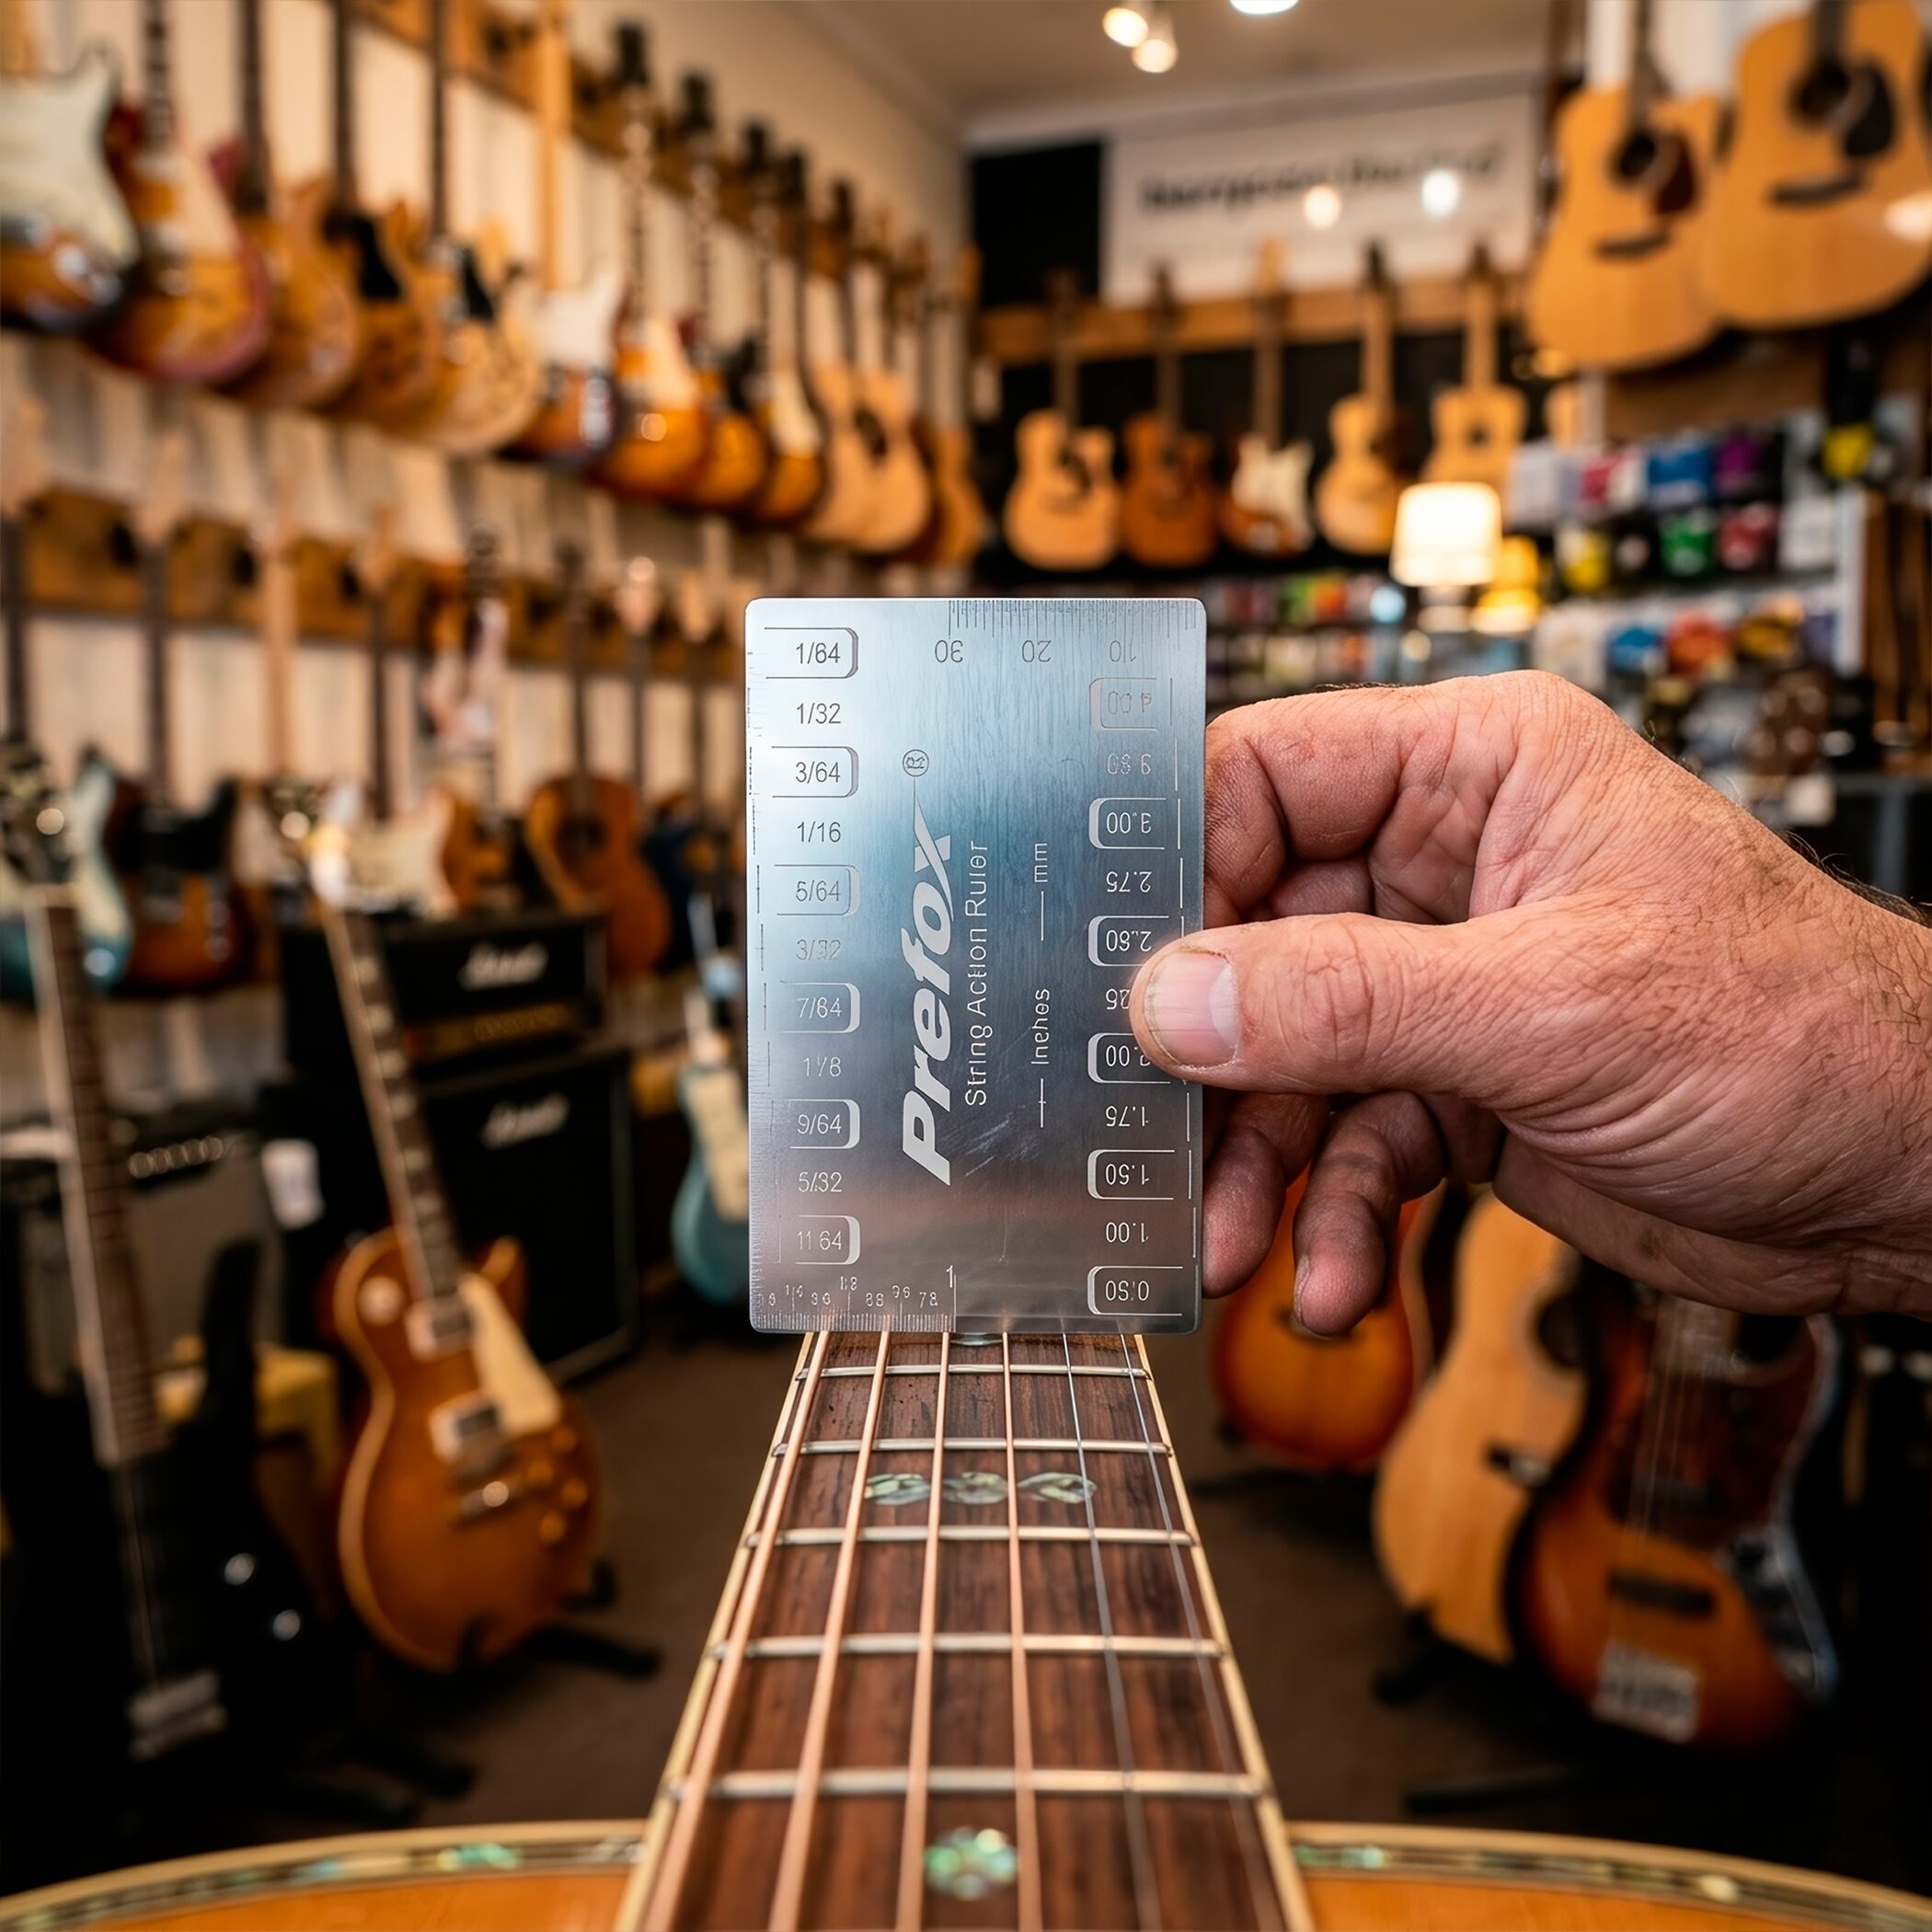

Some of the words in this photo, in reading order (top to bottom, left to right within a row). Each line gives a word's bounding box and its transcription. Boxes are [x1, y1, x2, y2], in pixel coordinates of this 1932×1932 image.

[795, 641, 841, 665] 1/64
[934, 639, 963, 662] 30
[1021, 639, 1052, 662] 20
[795, 702, 842, 725] 1/32
[795, 761, 841, 784] 3/64
[796, 821, 842, 843] 1/16
[1106, 811, 1152, 834] 3.00
[1034, 842, 1049, 883] mm
[795, 880, 841, 903] 5/64
[1106, 870, 1153, 893] 2.75
[903, 776, 954, 1186] Prefox
[964, 1024, 993, 1106] String
[797, 1113, 842, 1135] 9/64
[1105, 1163, 1150, 1186] 1.50
[1105, 1221, 1150, 1244] 1.00
